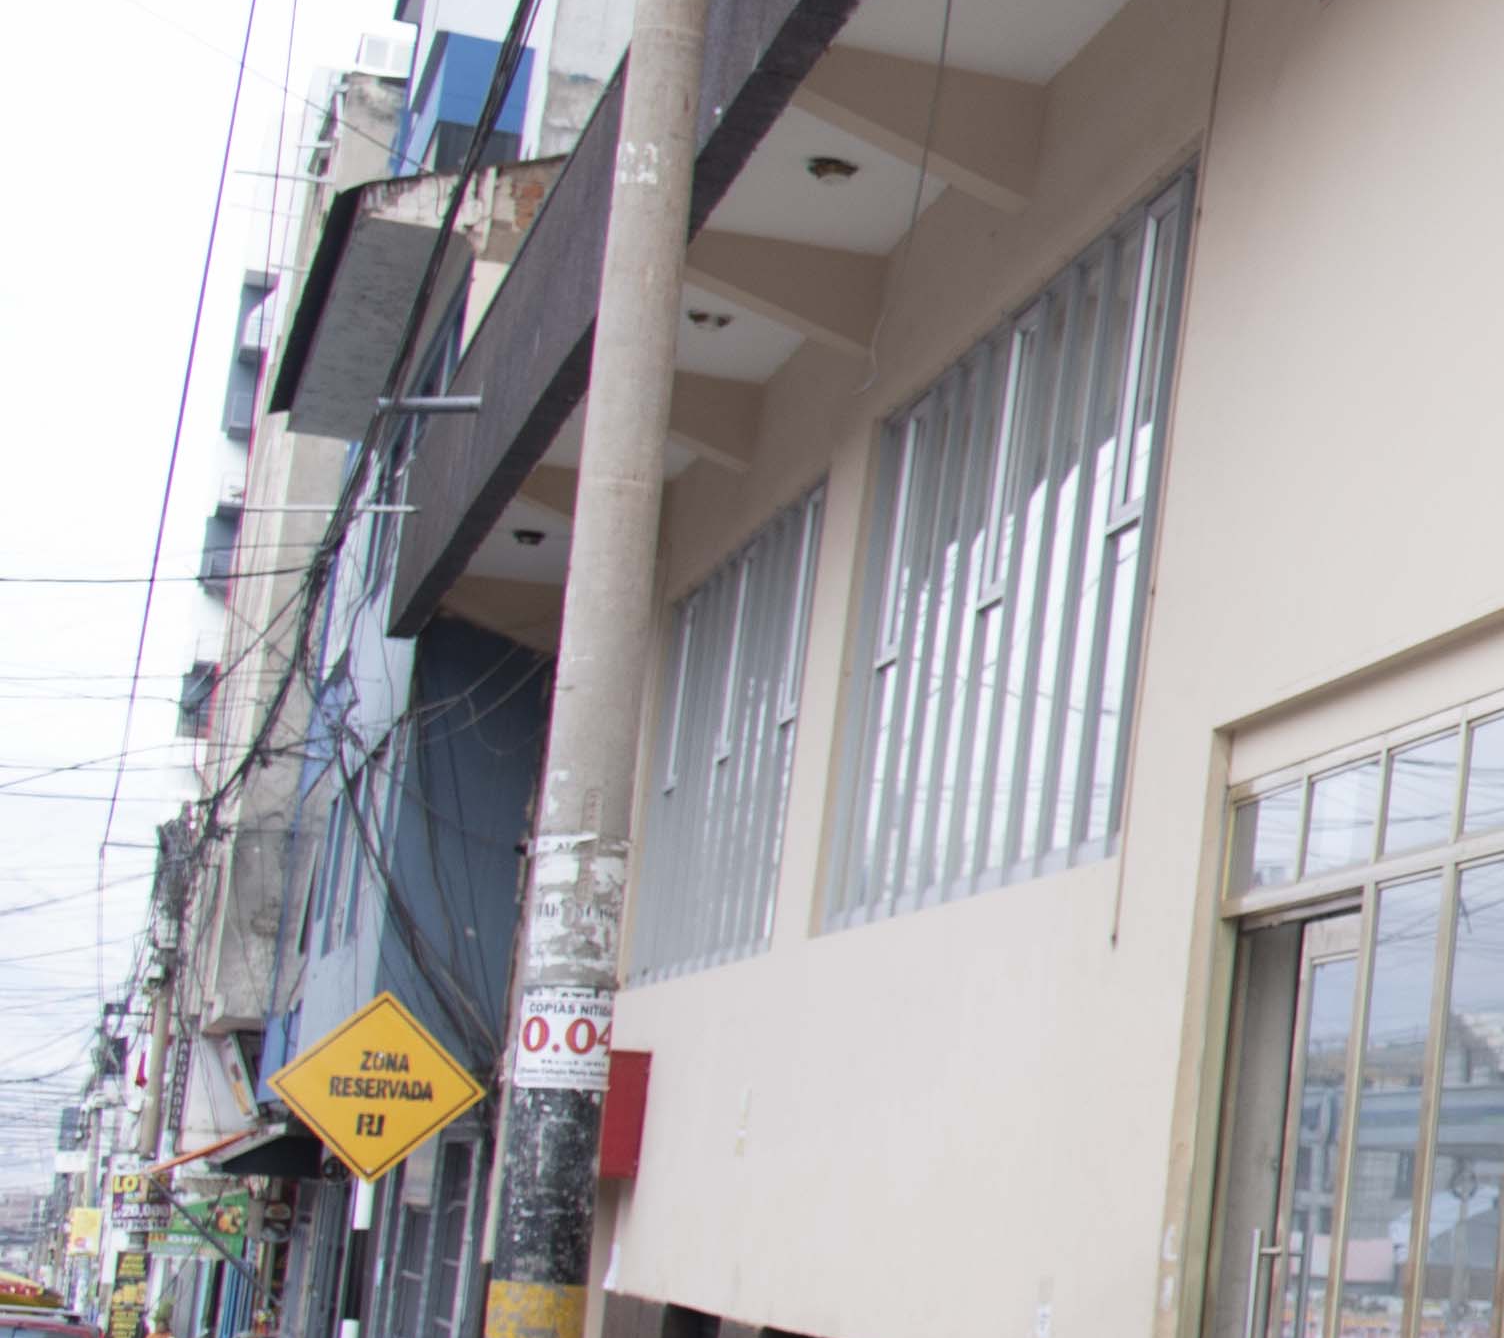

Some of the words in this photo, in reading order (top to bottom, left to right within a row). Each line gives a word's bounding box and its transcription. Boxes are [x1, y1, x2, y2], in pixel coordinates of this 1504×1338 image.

[529, 1003, 577, 1015] COPIAS
[360, 1050, 409, 1073] ZONA
[329, 1075, 434, 1102] RESERVADA
